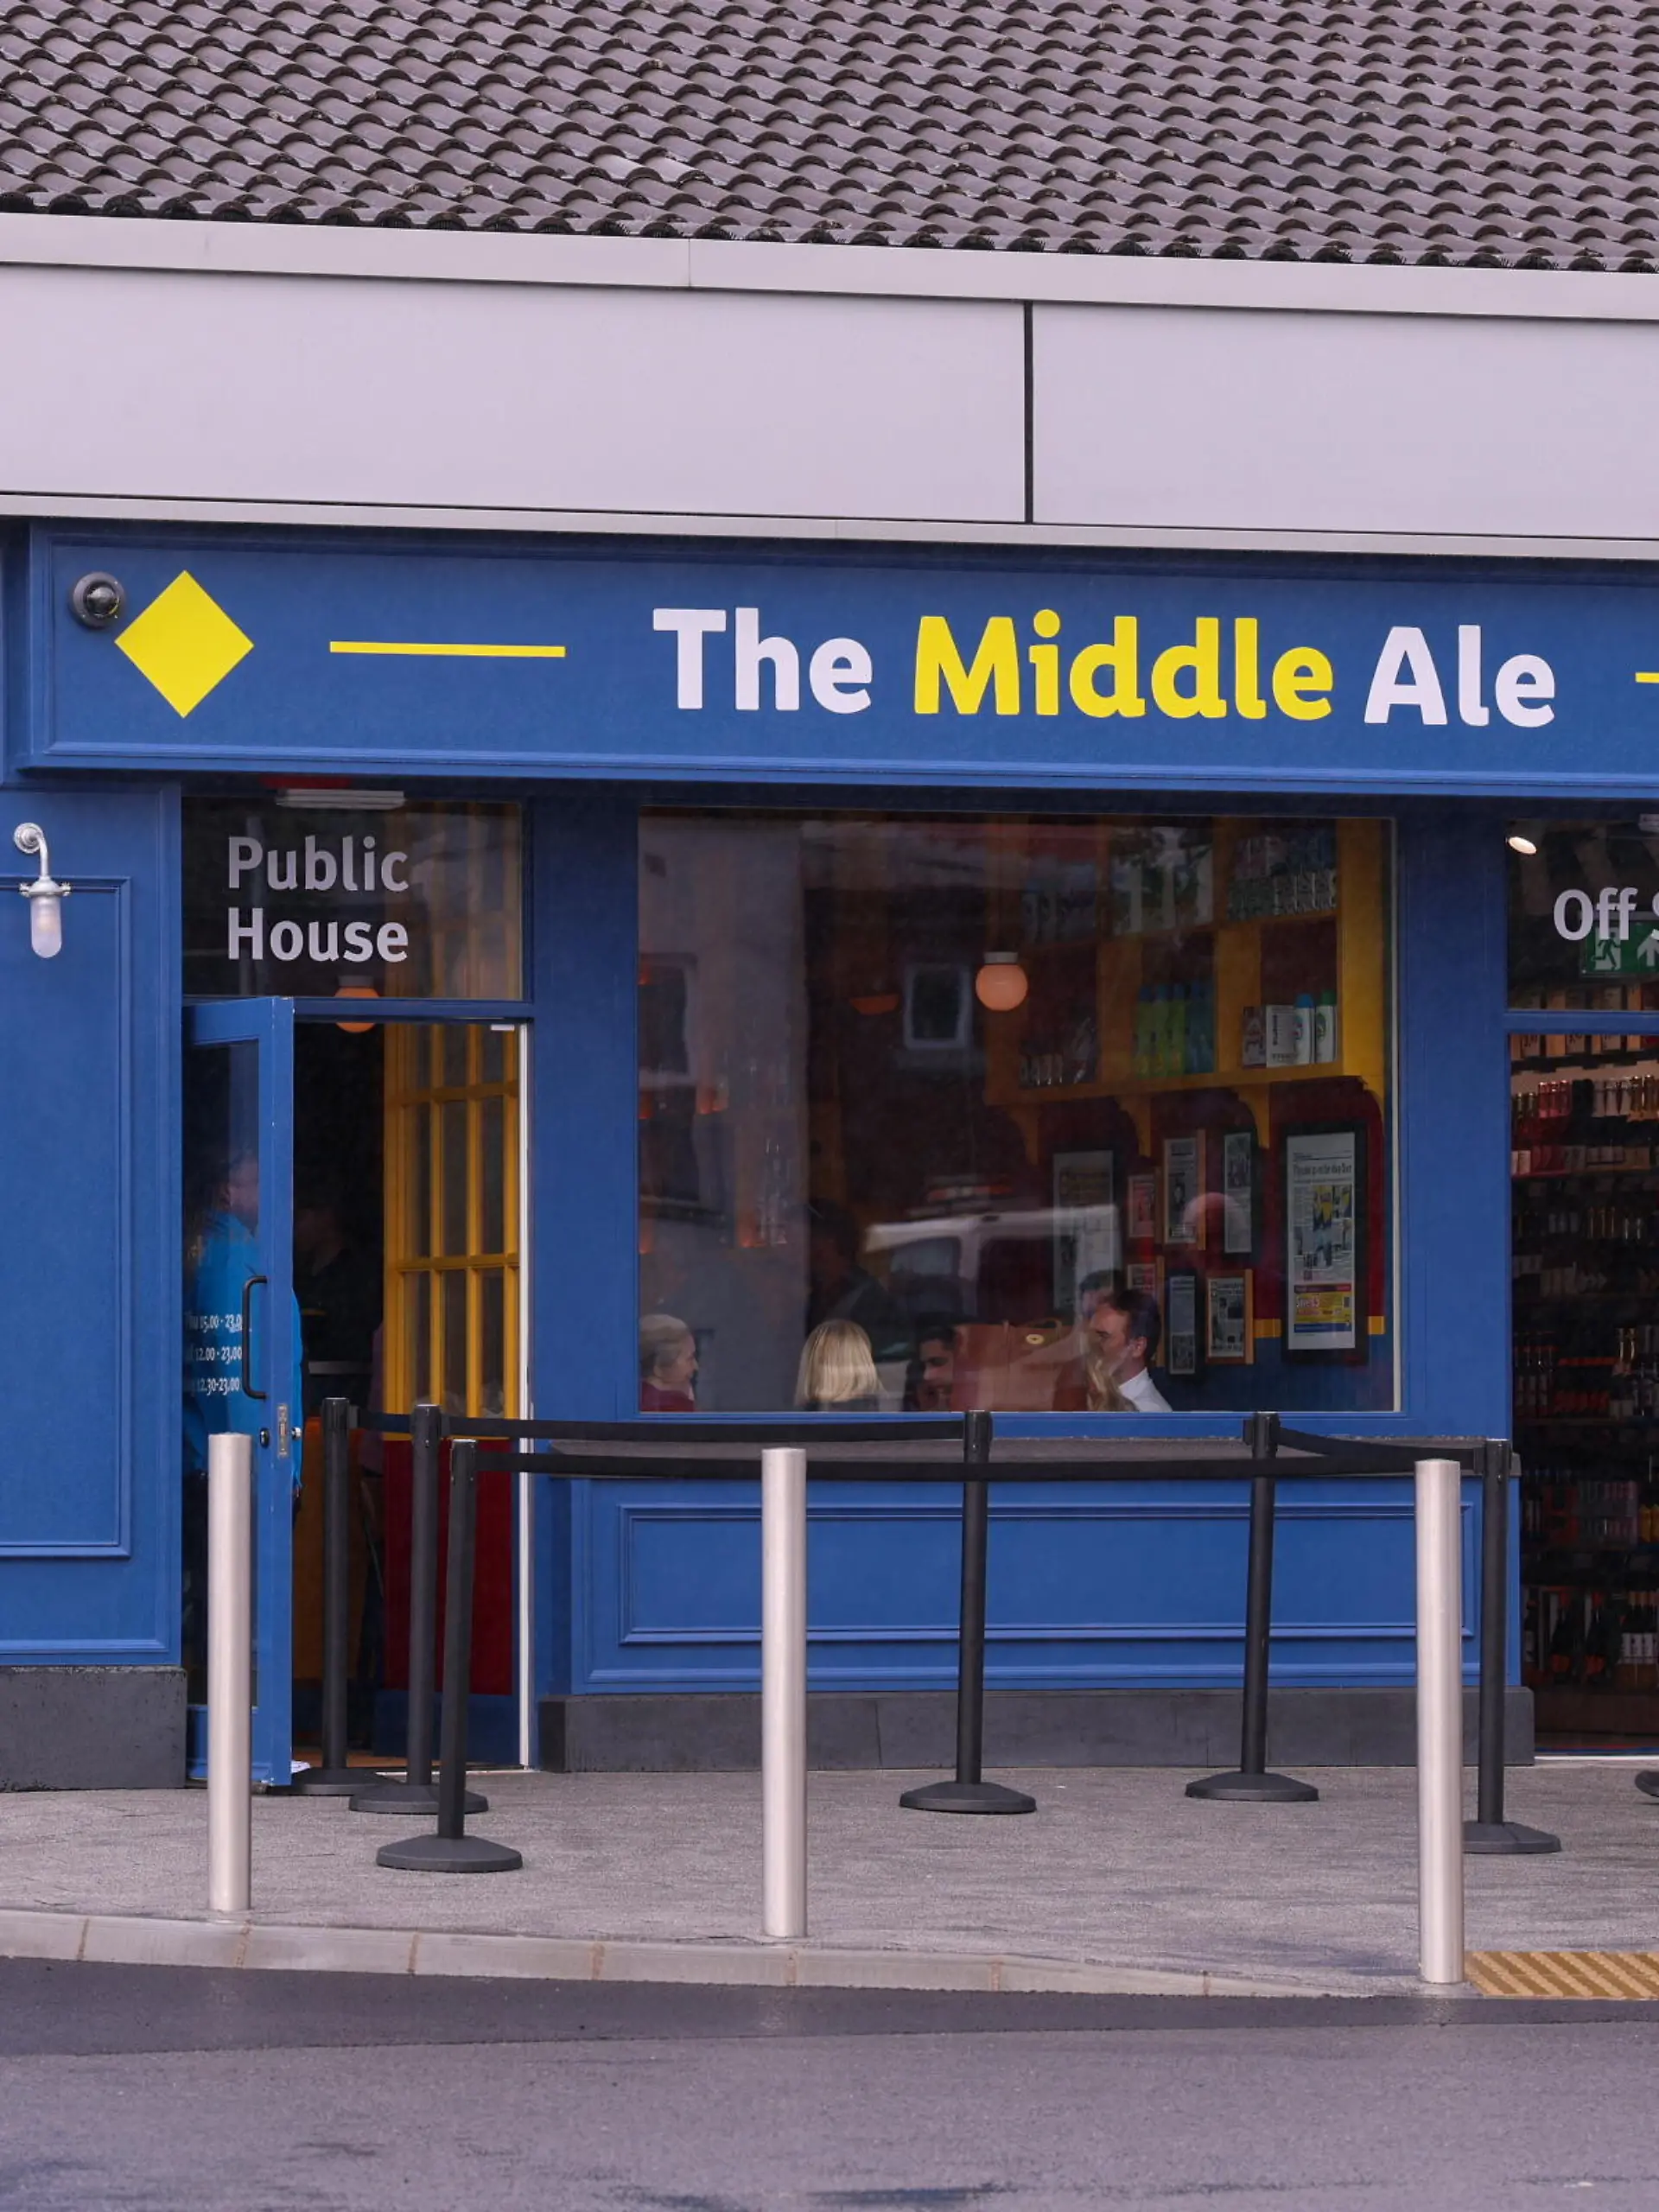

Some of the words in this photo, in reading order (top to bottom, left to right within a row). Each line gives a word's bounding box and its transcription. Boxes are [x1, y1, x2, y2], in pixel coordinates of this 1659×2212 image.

[653, 607, 872, 714] The
[914, 609, 1333, 721] Middle
[1364, 625, 1554, 728] Ale
[229, 836, 408, 891] Public
[229, 908, 408, 962] House
[1554, 887, 1638, 940] Off
[225, 1313, 243, 1333] 23.0
